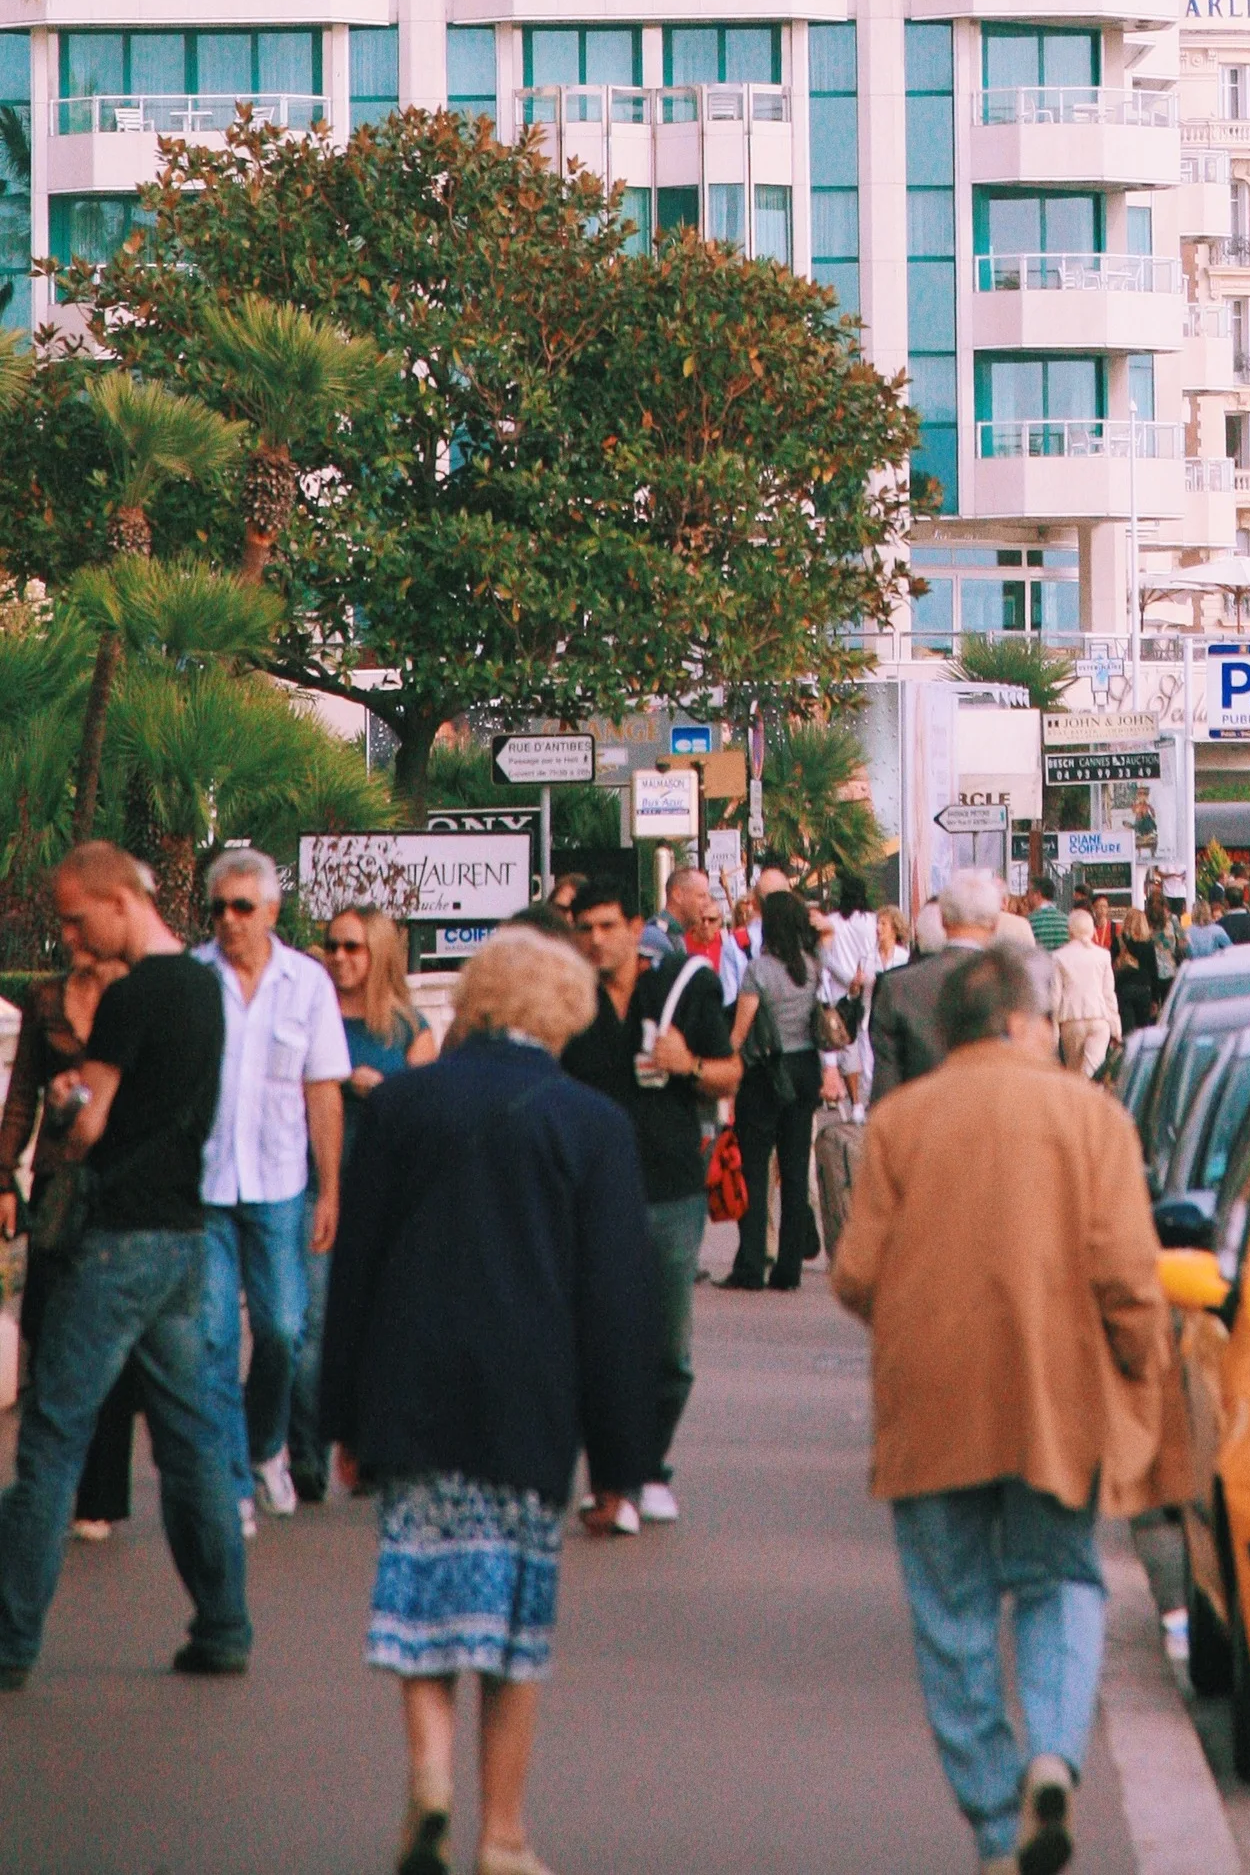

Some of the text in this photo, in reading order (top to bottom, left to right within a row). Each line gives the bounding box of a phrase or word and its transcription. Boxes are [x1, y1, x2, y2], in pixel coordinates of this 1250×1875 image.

[1064, 714, 1155, 728] JOHN & JOHN
[508, 741, 593, 753] RUE D'ANTIBES
[1078, 756, 1110, 768] CANNES
[1126, 754, 1159, 766] AUCTION
[1056, 767, 1152, 781] 04 93 99 33 49
[1069, 833, 1102, 845] DIANE
[1069, 843, 1122, 855] COIFFURE
[416, 855, 518, 893] LAURENT
